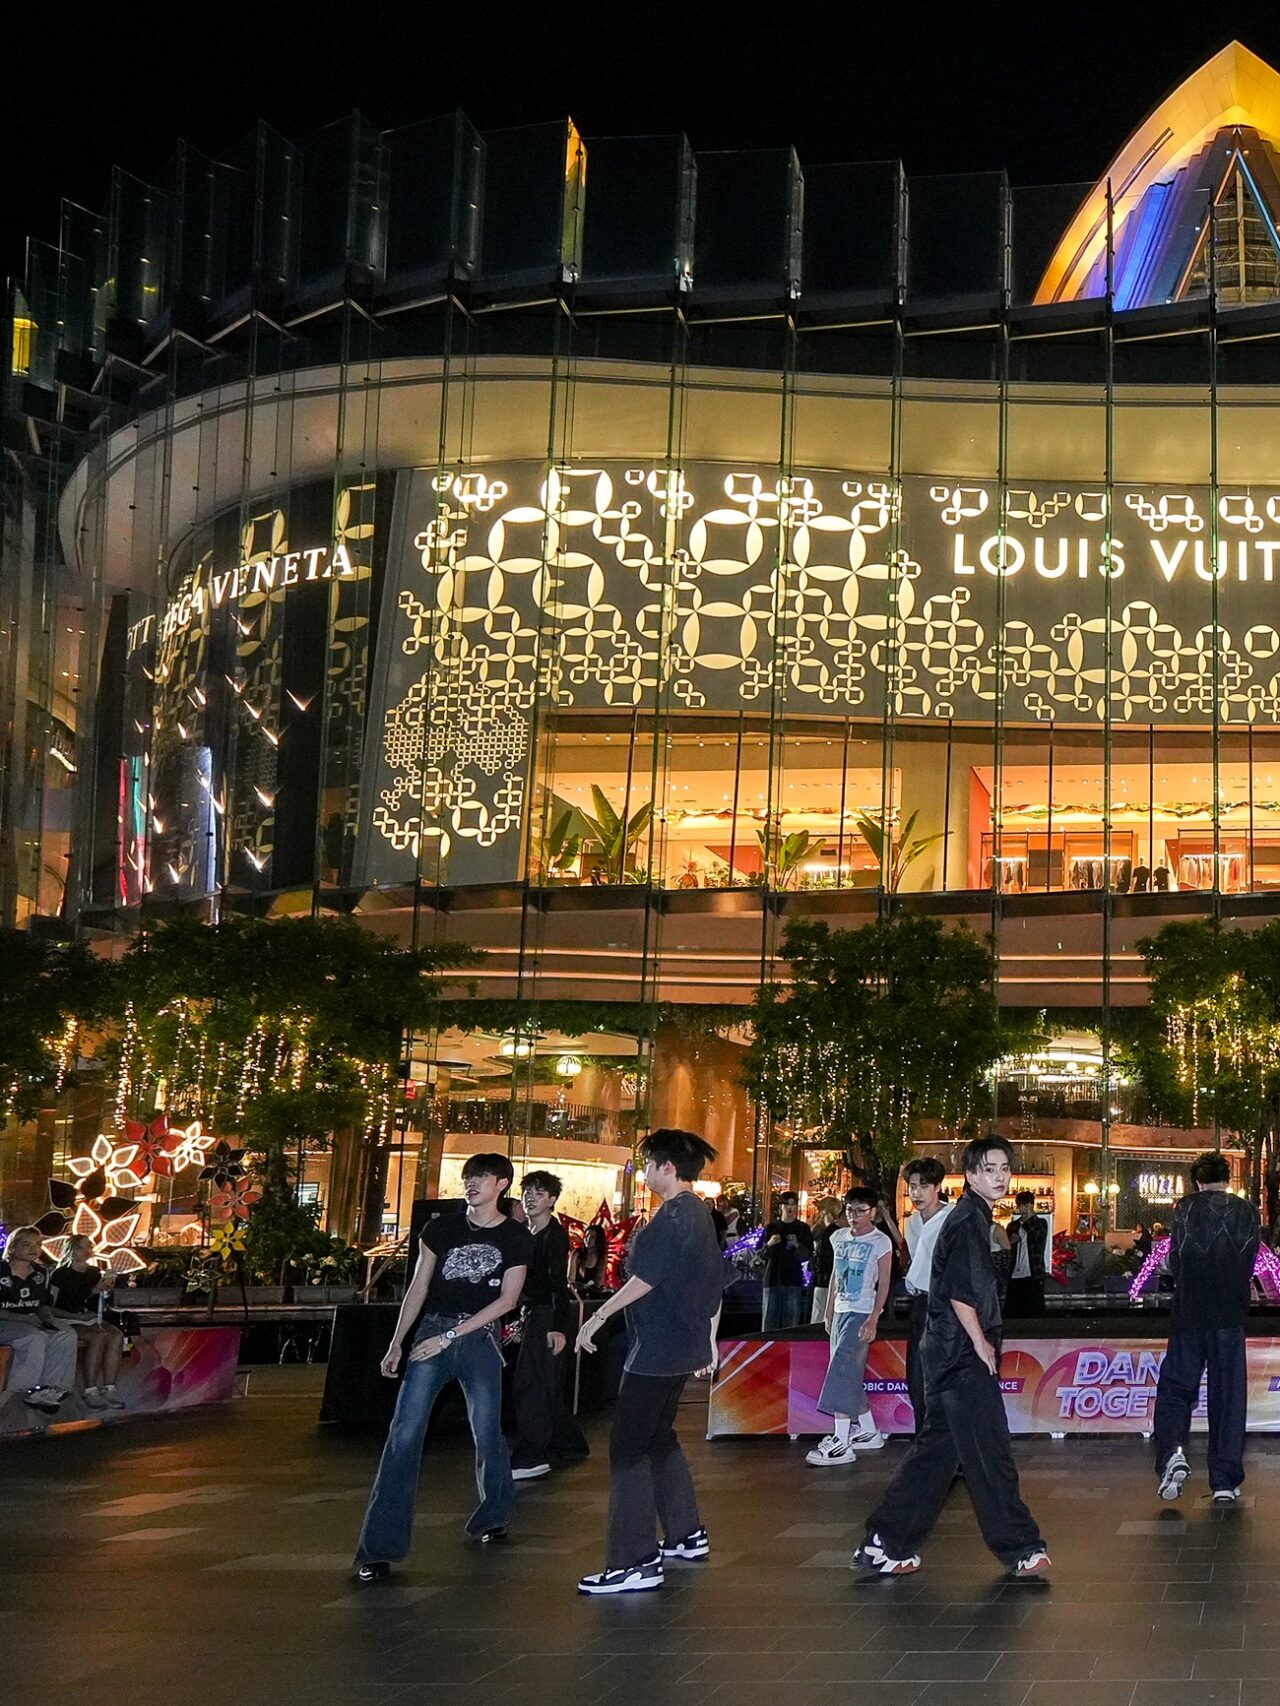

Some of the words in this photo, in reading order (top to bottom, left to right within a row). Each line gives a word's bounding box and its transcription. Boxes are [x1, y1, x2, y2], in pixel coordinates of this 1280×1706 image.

[213, 544, 354, 604] VENETA
[953, 533, 1125, 579] LOUIS
[887, 1382, 909, 1391] DAN
[998, 1381, 1018, 1390] NCE
[1072, 1351, 1207, 1385] DAN
